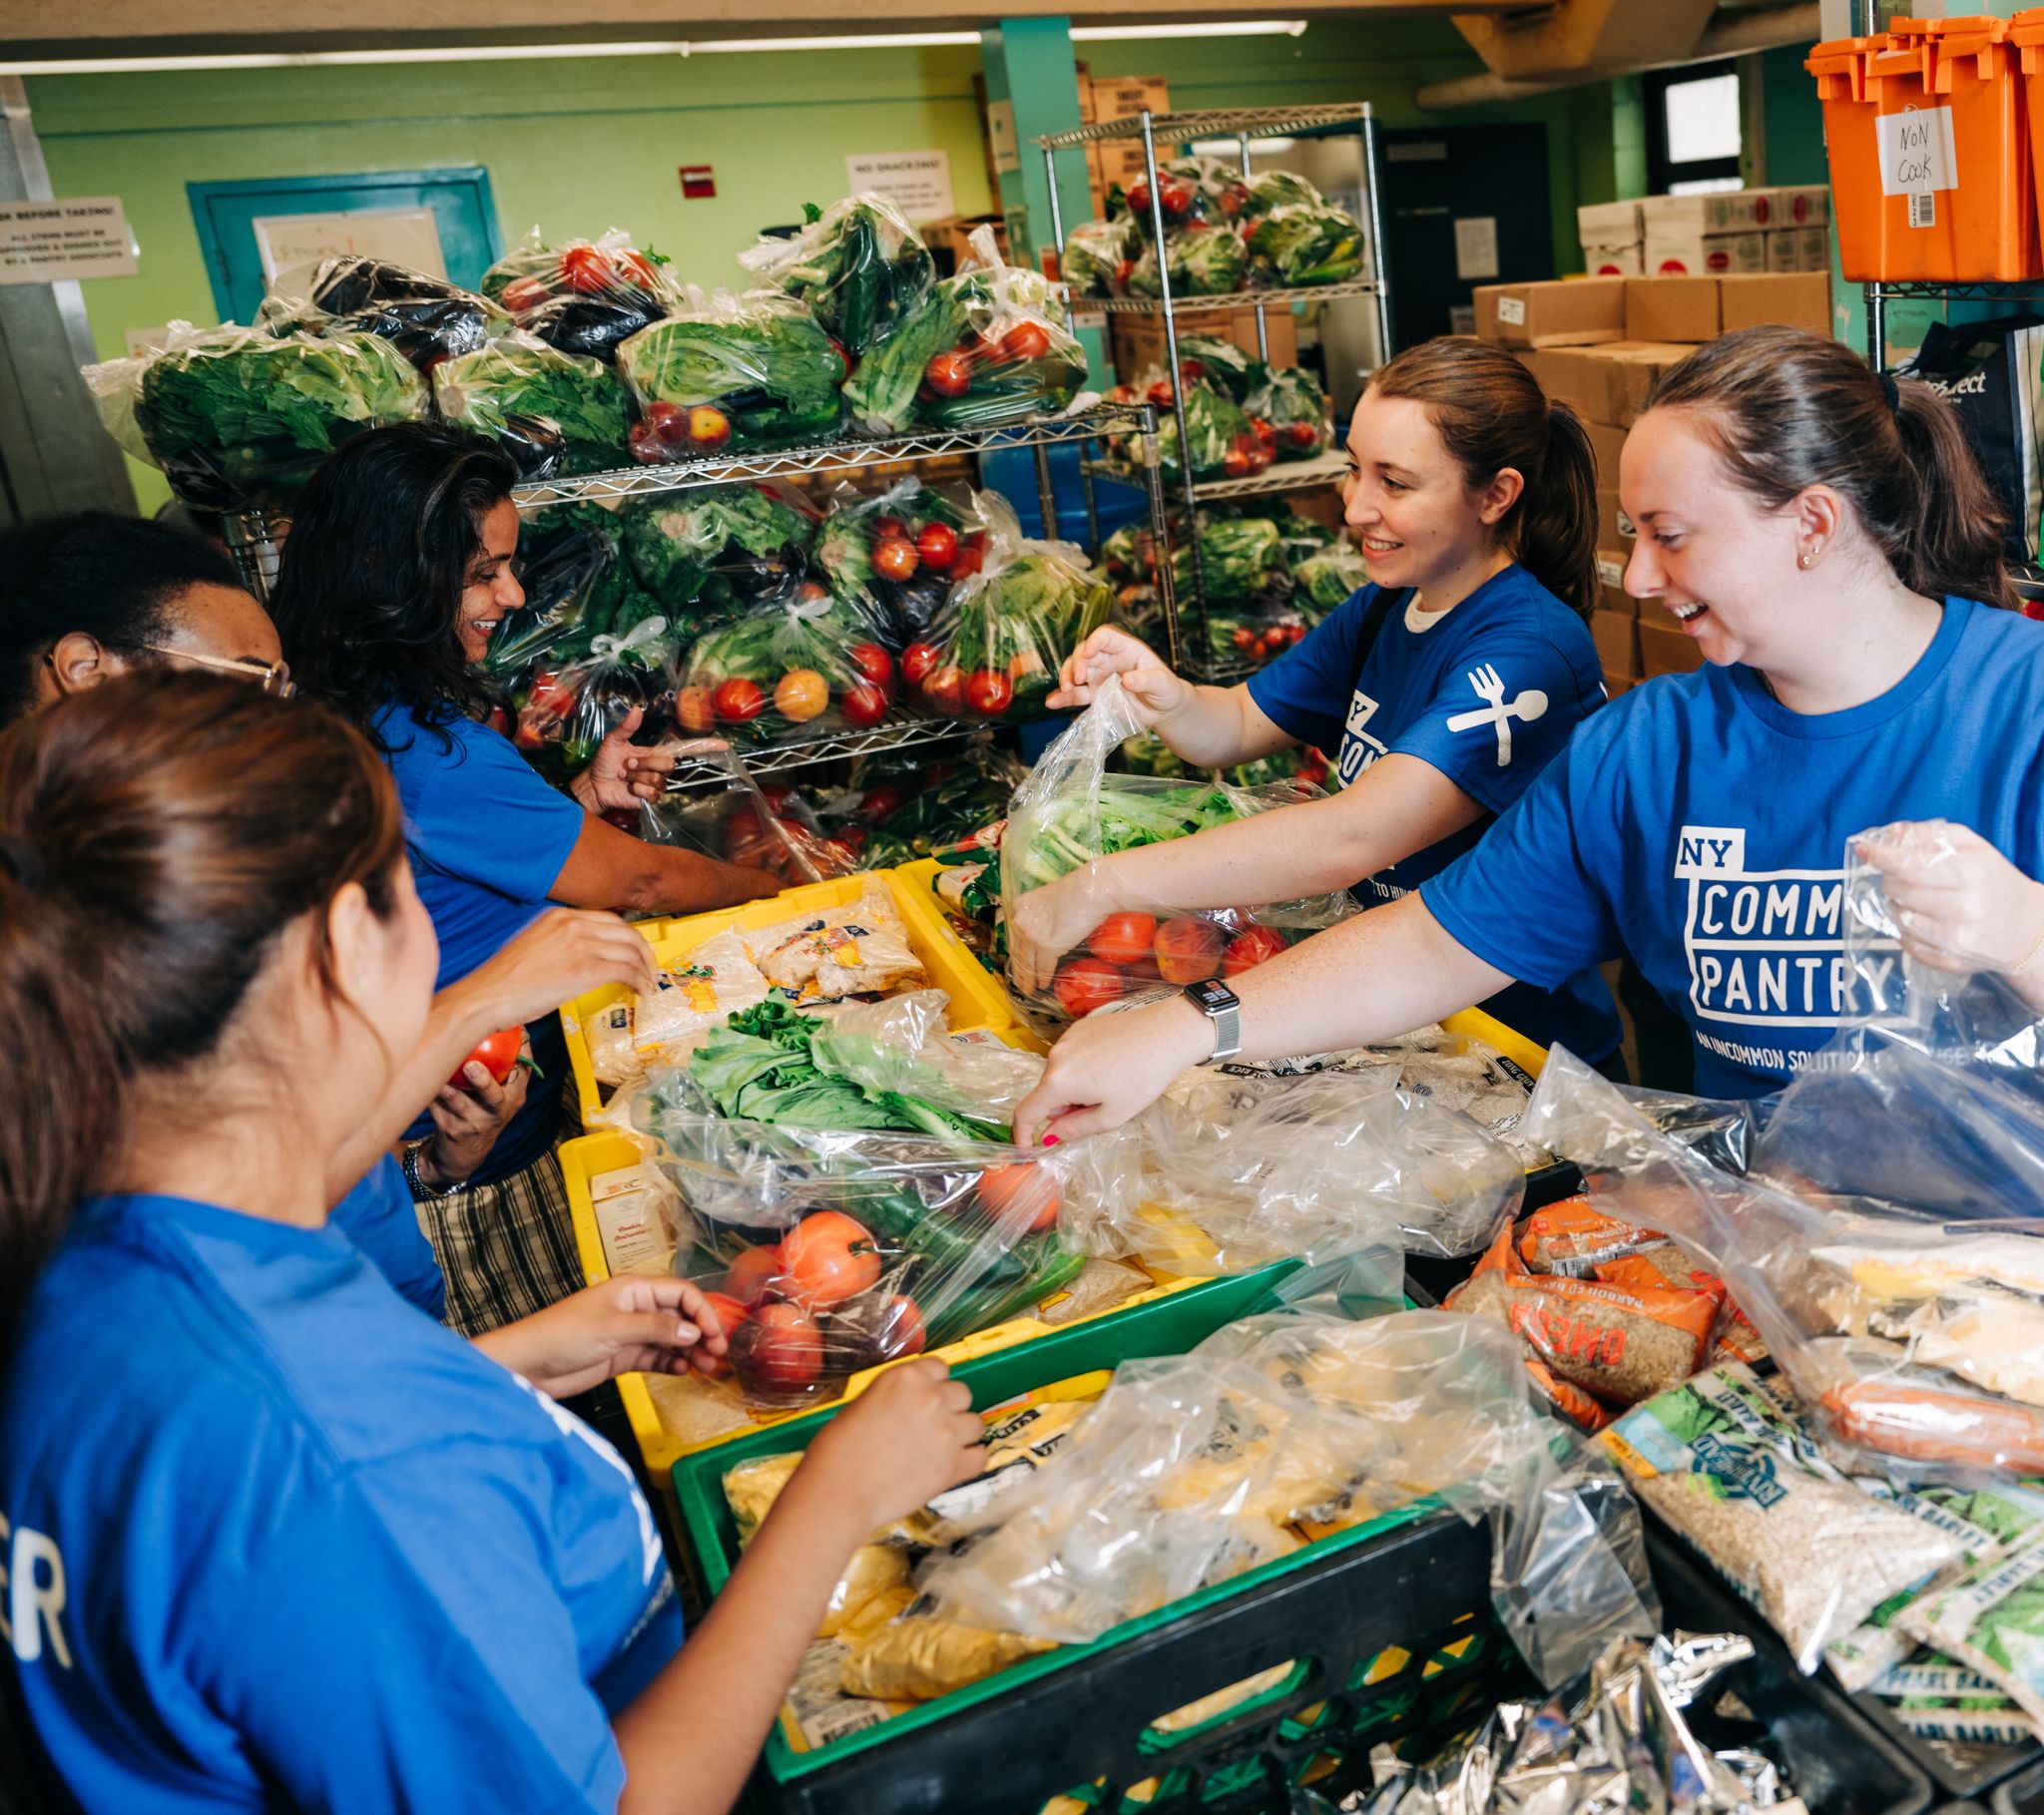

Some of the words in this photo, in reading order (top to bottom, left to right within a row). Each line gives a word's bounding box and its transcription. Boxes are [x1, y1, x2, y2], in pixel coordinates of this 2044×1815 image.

[16, 210, 61, 220] BEFORE
[1350, 700, 1368, 721] Y
[1680, 837, 1733, 868] NY
[1375, 882, 1389, 897] TO
[1702, 883, 1873, 936] COMMO
[1701, 955, 1894, 1012] PANTRY
[1696, 1030, 1712, 1049] AN
[1711, 1036, 1785, 1070] UNCOMMON
[1229, 1065, 1253, 1076] RICE
[1511, 1300, 1626, 1366] OMEGA
